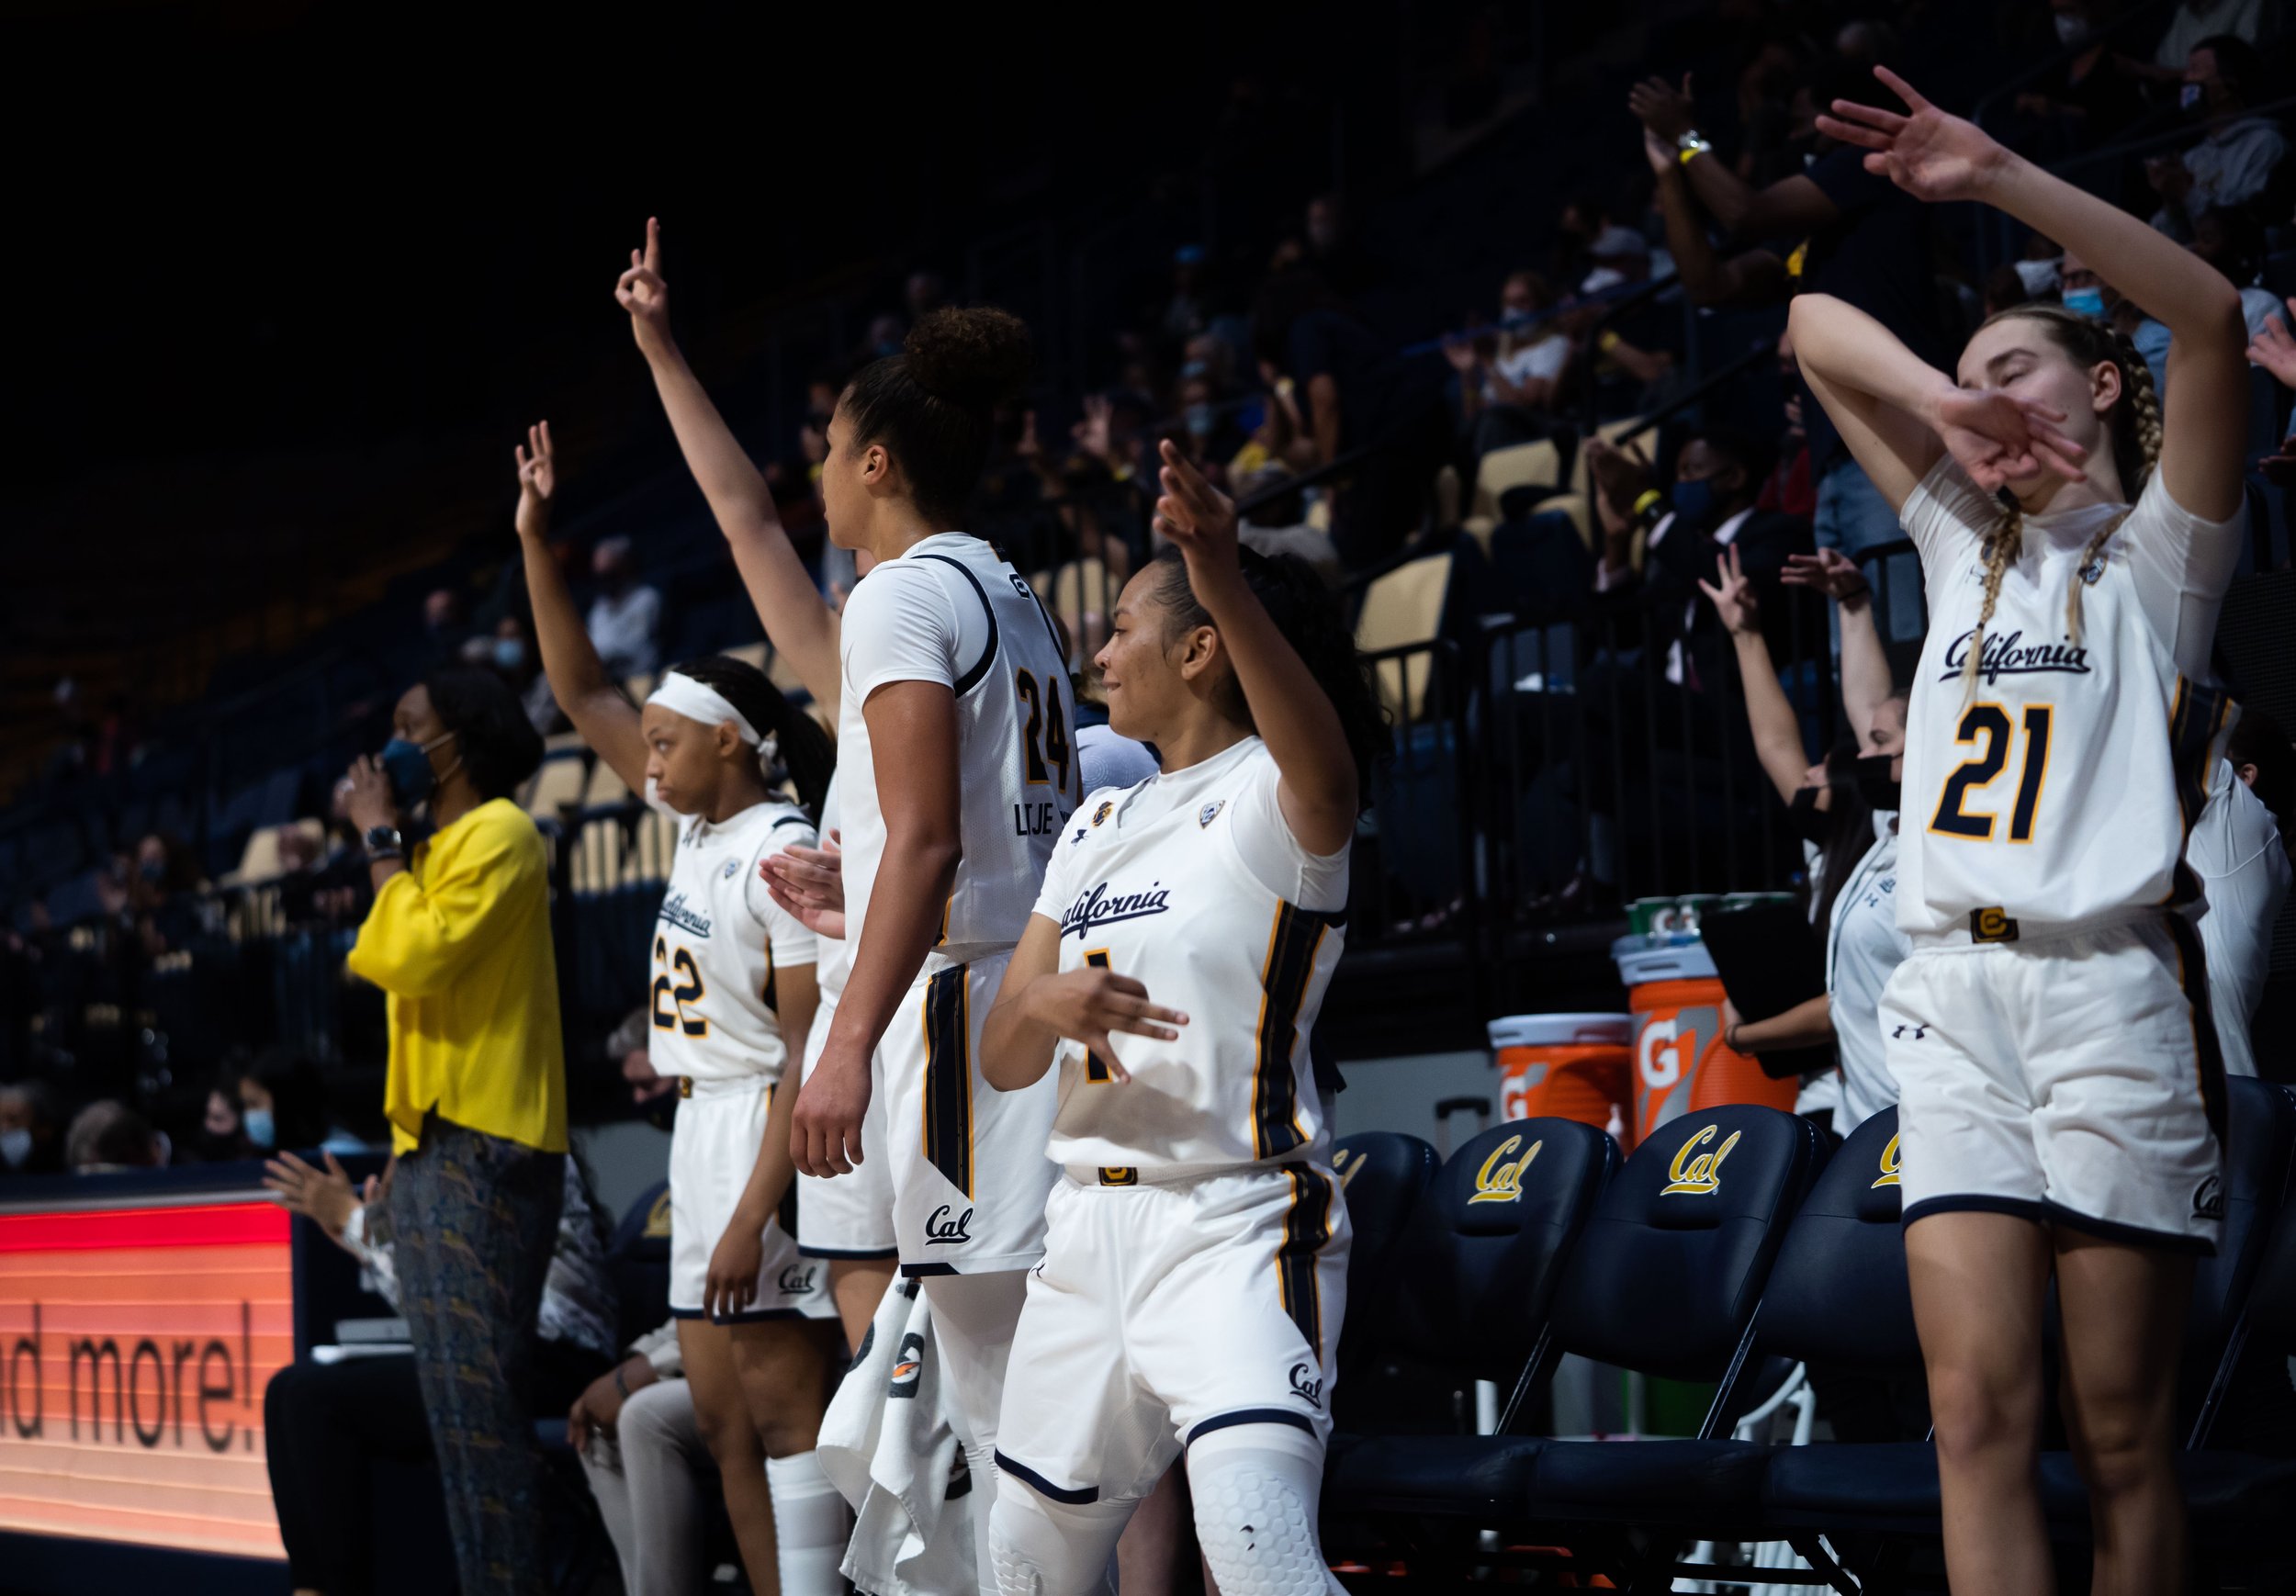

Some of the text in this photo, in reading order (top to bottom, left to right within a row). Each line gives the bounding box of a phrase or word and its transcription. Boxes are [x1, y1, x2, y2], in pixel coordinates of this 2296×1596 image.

[1016, 667, 1072, 794] 24
[1926, 701, 2054, 844] 21
[1061, 882, 1171, 940] alifornia
[650, 934, 709, 1039] 22
[1639, 1019, 1680, 1089] G
[1468, 1134, 1543, 1204] Cal
[1660, 1124, 1741, 1196] Cal
[924, 1204, 974, 1246] Cal
[779, 1264, 816, 1296] Cal
[0, 1300, 253, 1453] d more!
[1289, 1362, 1322, 1410] Cal
